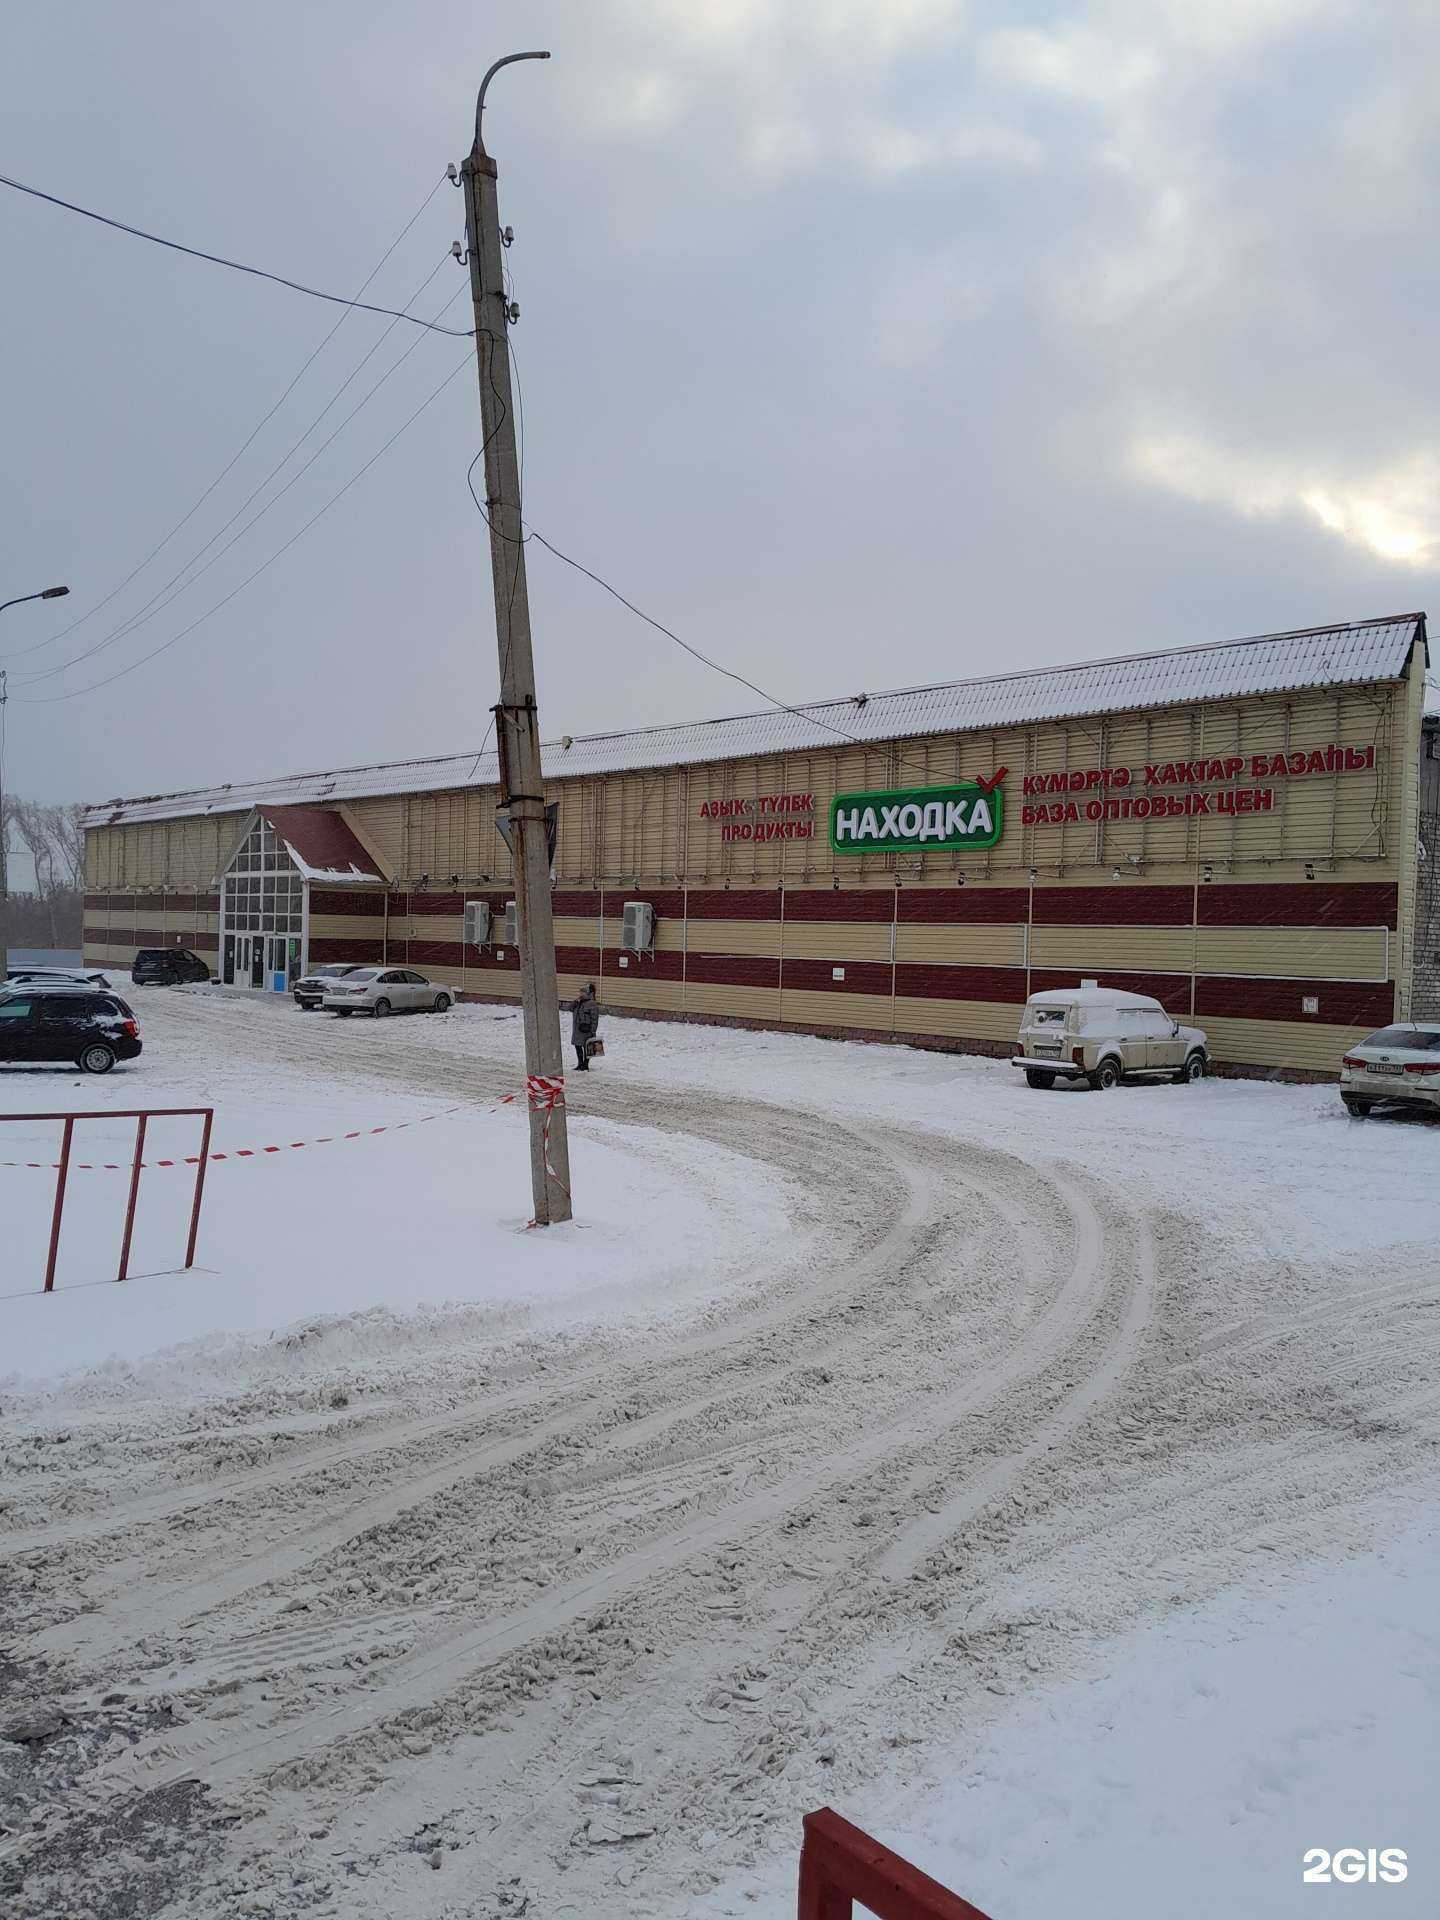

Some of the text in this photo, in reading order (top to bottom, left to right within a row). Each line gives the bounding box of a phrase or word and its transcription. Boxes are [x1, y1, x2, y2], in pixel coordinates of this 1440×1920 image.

[835, 798, 994, 842] НАХОДКА
[1021, 787, 1274, 825] БАЗА ОПТОВЫХ ЦЕН
[721, 820, 817, 842] ПРОДУКТЫ
